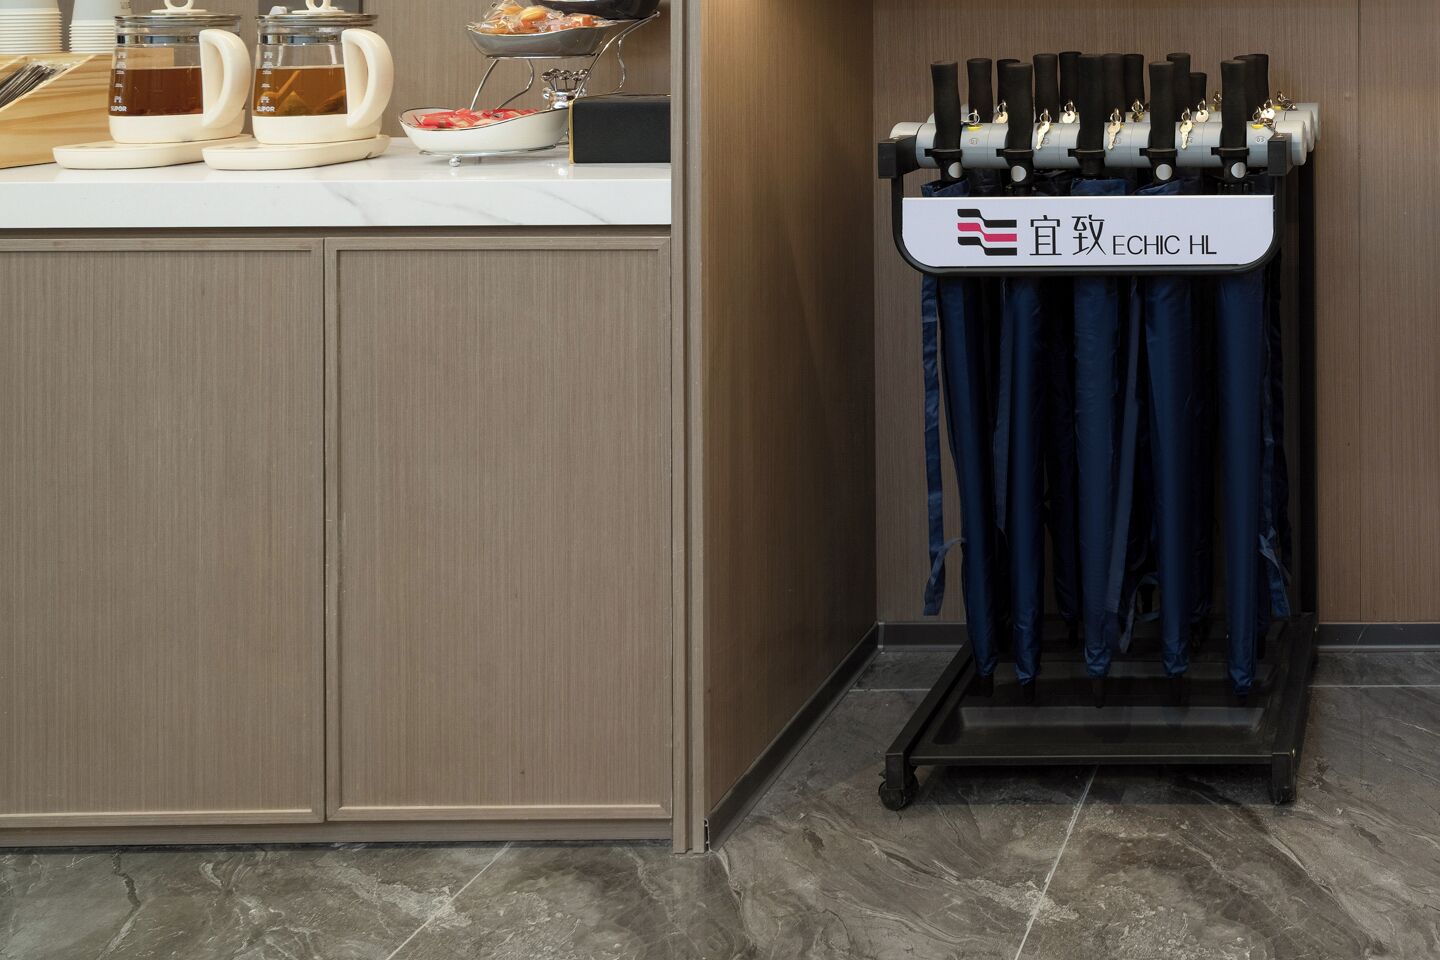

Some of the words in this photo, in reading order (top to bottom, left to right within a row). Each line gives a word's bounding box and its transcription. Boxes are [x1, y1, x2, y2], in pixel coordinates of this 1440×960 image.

[1029, 214, 1107, 256] 宜致
[1112, 234, 1181, 256] ECHIC
[1189, 234, 1218, 255] HL
